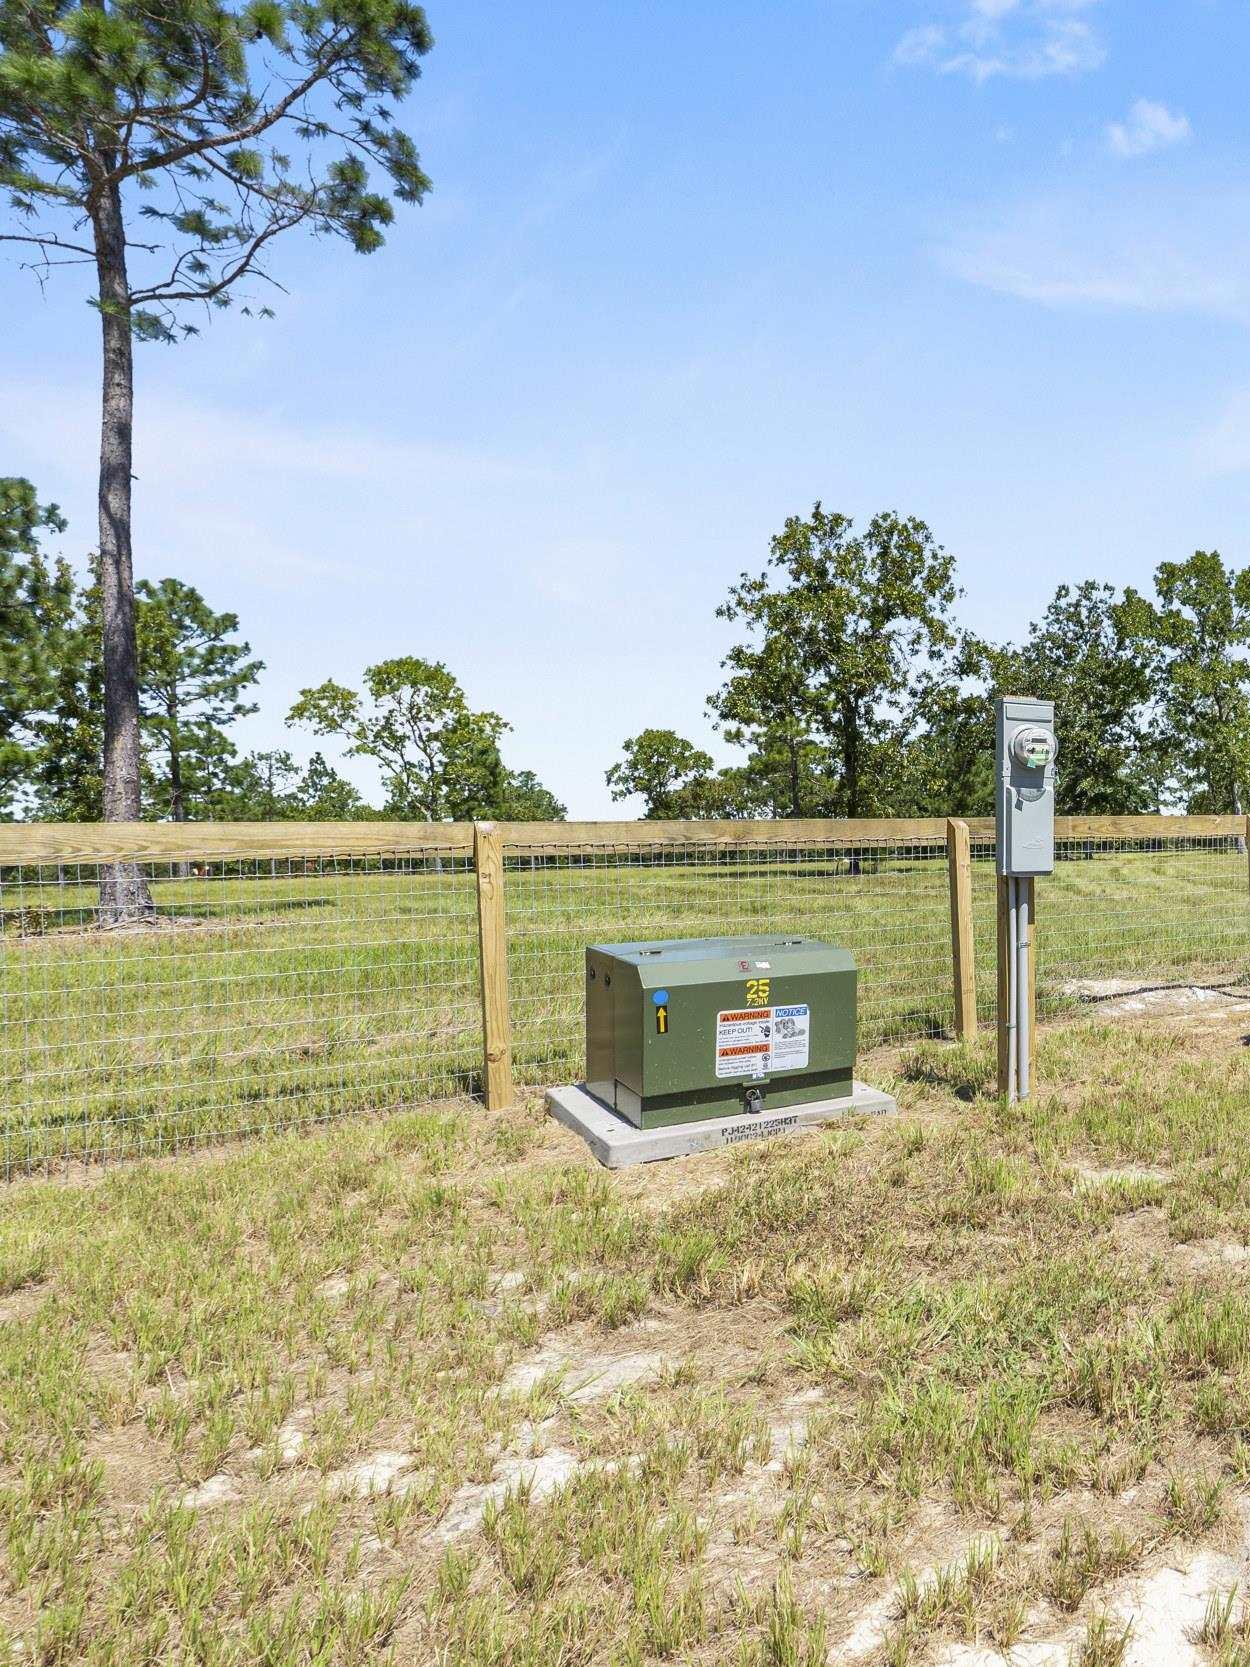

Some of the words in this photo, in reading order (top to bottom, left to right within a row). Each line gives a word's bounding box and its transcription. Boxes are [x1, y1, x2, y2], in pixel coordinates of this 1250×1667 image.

[746, 979, 770, 999] 25
[730, 1010, 768, 1021] WARNING
[776, 1007, 806, 1017] NOTICE
[719, 1028, 737, 1036] KEEP
[738, 1026, 753, 1035] OUT!
[729, 1044, 768, 1057] WARNING
